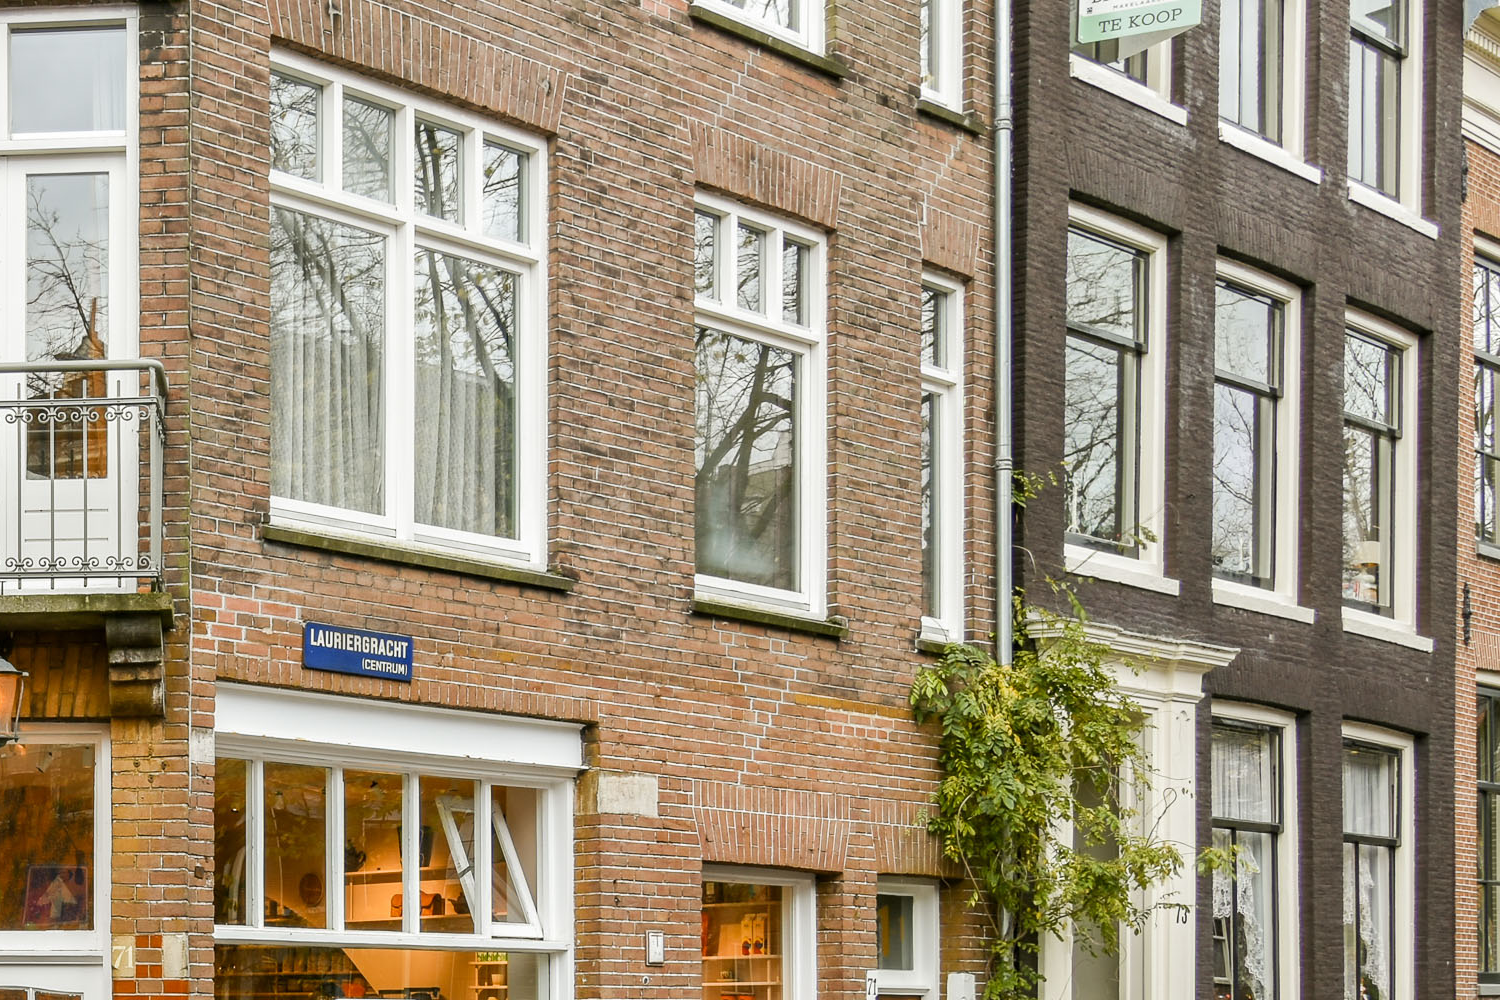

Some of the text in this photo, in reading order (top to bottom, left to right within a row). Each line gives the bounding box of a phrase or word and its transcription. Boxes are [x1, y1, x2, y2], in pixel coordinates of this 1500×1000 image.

[1098, 8, 1183, 33] TE KOOP
[310, 628, 408, 659] LAURIERGRACHT
[361, 658, 408, 676] (CENTRUM)
[112, 945, 134, 969] 71
[867, 978, 878, 996] 71
